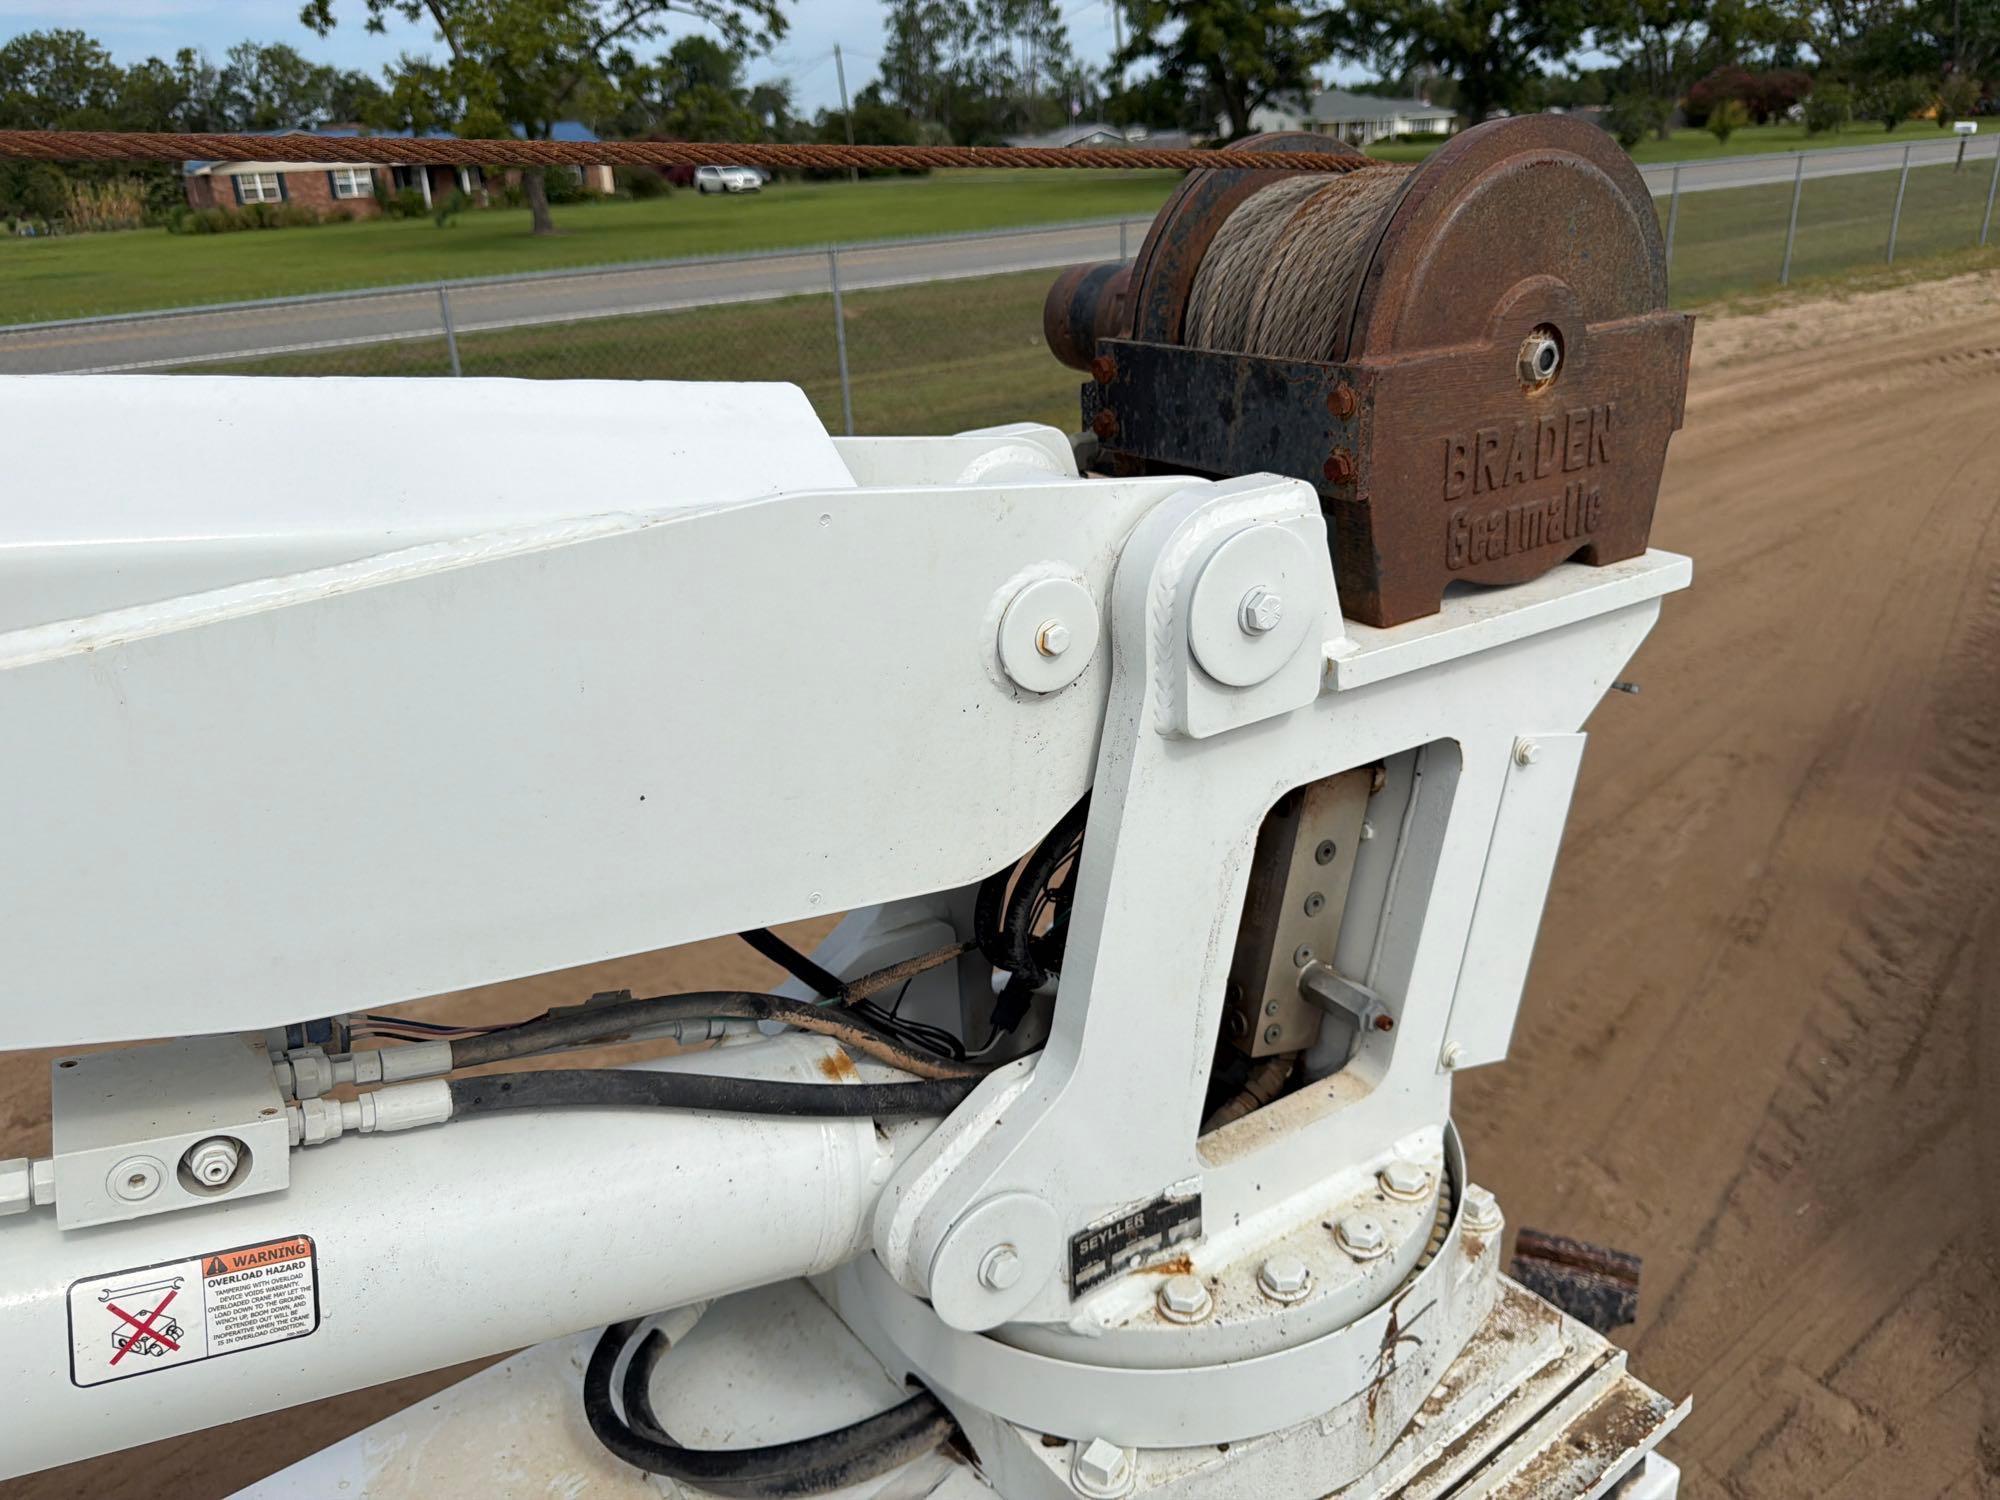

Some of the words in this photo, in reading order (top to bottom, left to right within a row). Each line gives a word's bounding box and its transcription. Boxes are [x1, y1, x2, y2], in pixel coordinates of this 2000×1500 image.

[1443, 402, 1616, 501] BRADEN
[1445, 480, 1601, 571] Gearmatic
[1079, 1212, 1145, 1256] SEYLLER
[232, 1244, 306, 1267] WARNING
[208, 1269, 263, 1288] OVERLOAD
[266, 1261, 306, 1276] HAZARD
[215, 1284, 251, 1296] TAMPERING
[252, 1280, 270, 1288] WITH
[271, 1273, 304, 1284] OVERLOAD
[208, 1300, 250, 1313] OVERLOADED
[251, 1294, 272, 1304] CRANE
[273, 1290, 286, 1298] MAY
[220, 1293, 243, 1303] DEVICE
[244, 1288, 264, 1297] VOIDS
[214, 1310, 231, 1319] LOAD
[233, 1306, 253, 1314] DOWN
[216, 1316, 238, 1326] WINCH
[250, 1309, 269, 1318] BOOM
[214, 1326, 255, 1340] INOPERATIVE
[256, 1322, 275, 1330] WHEN
[290, 1313, 310, 1322] CRANE
[224, 1319, 258, 1330] EXTENDED
[235, 1330, 268, 1342] OVERLOAD
